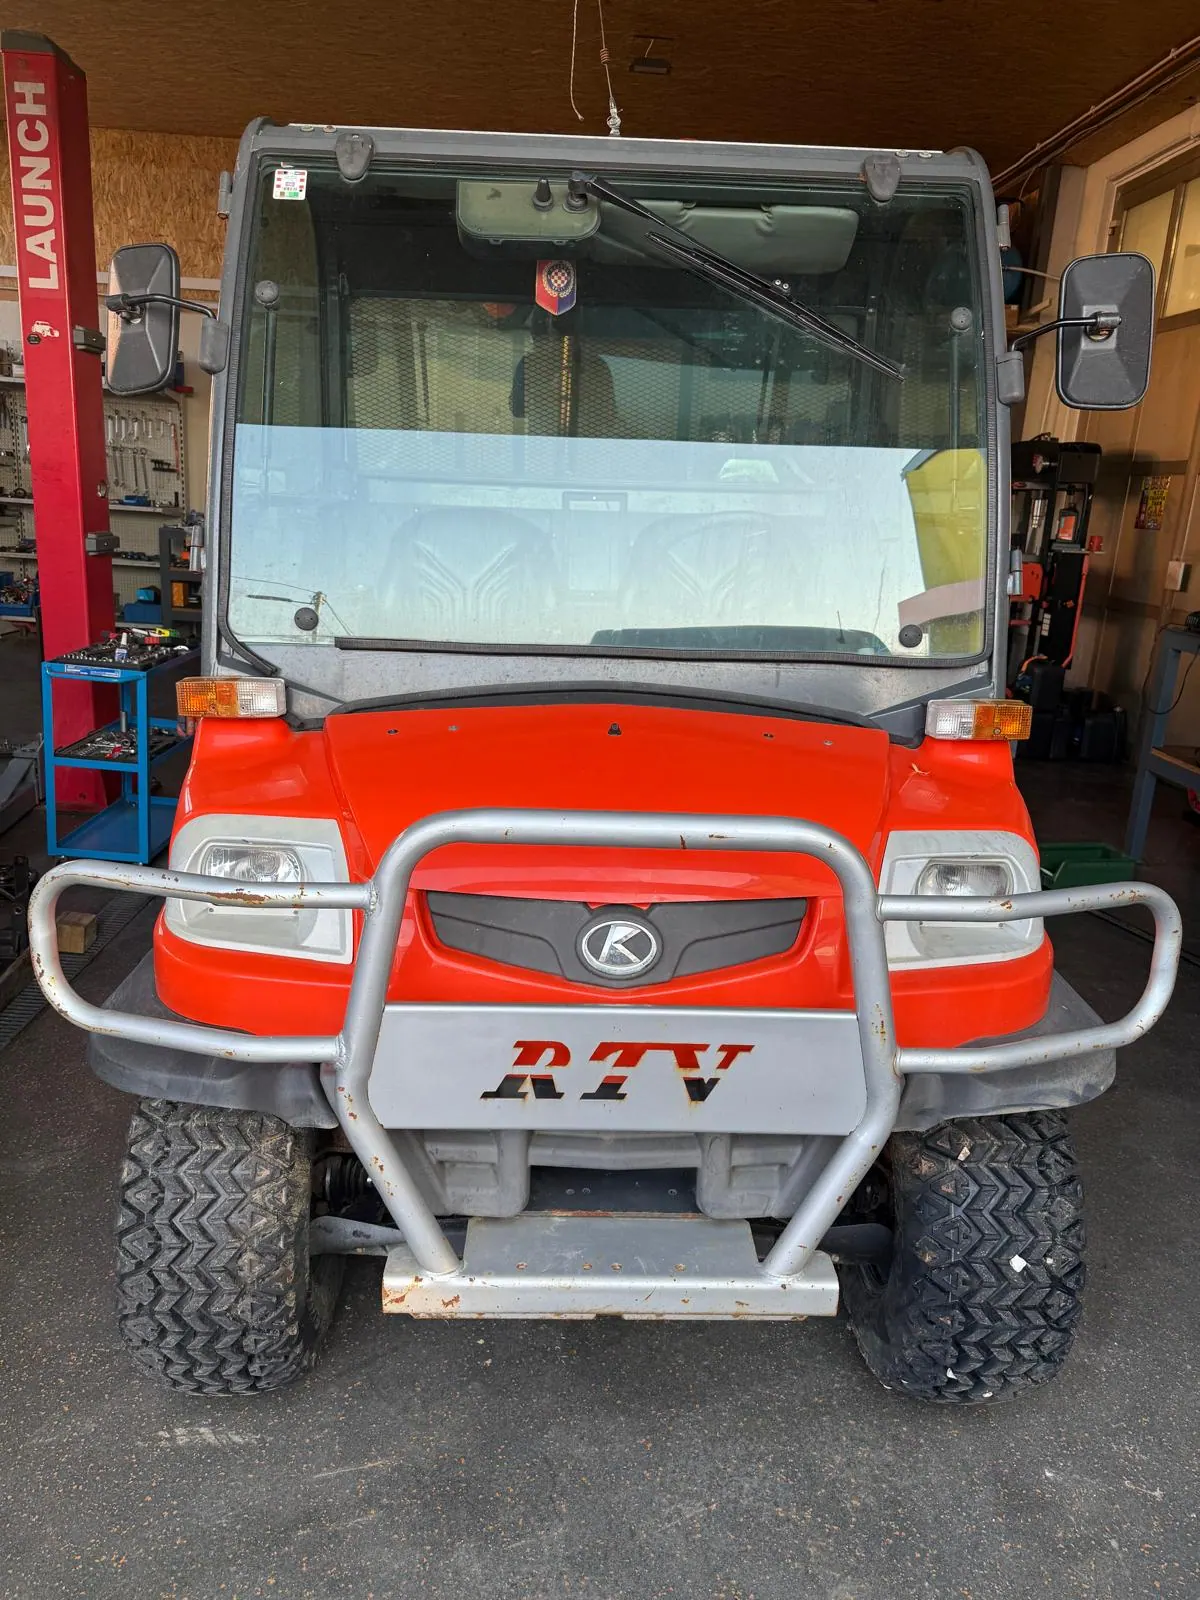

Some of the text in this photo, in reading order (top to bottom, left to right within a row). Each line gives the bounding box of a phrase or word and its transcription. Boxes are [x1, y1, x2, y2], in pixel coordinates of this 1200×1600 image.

[14, 81, 59, 290] LAUNCH
[599, 924, 642, 964] K
[480, 1040, 756, 1102] RTV
